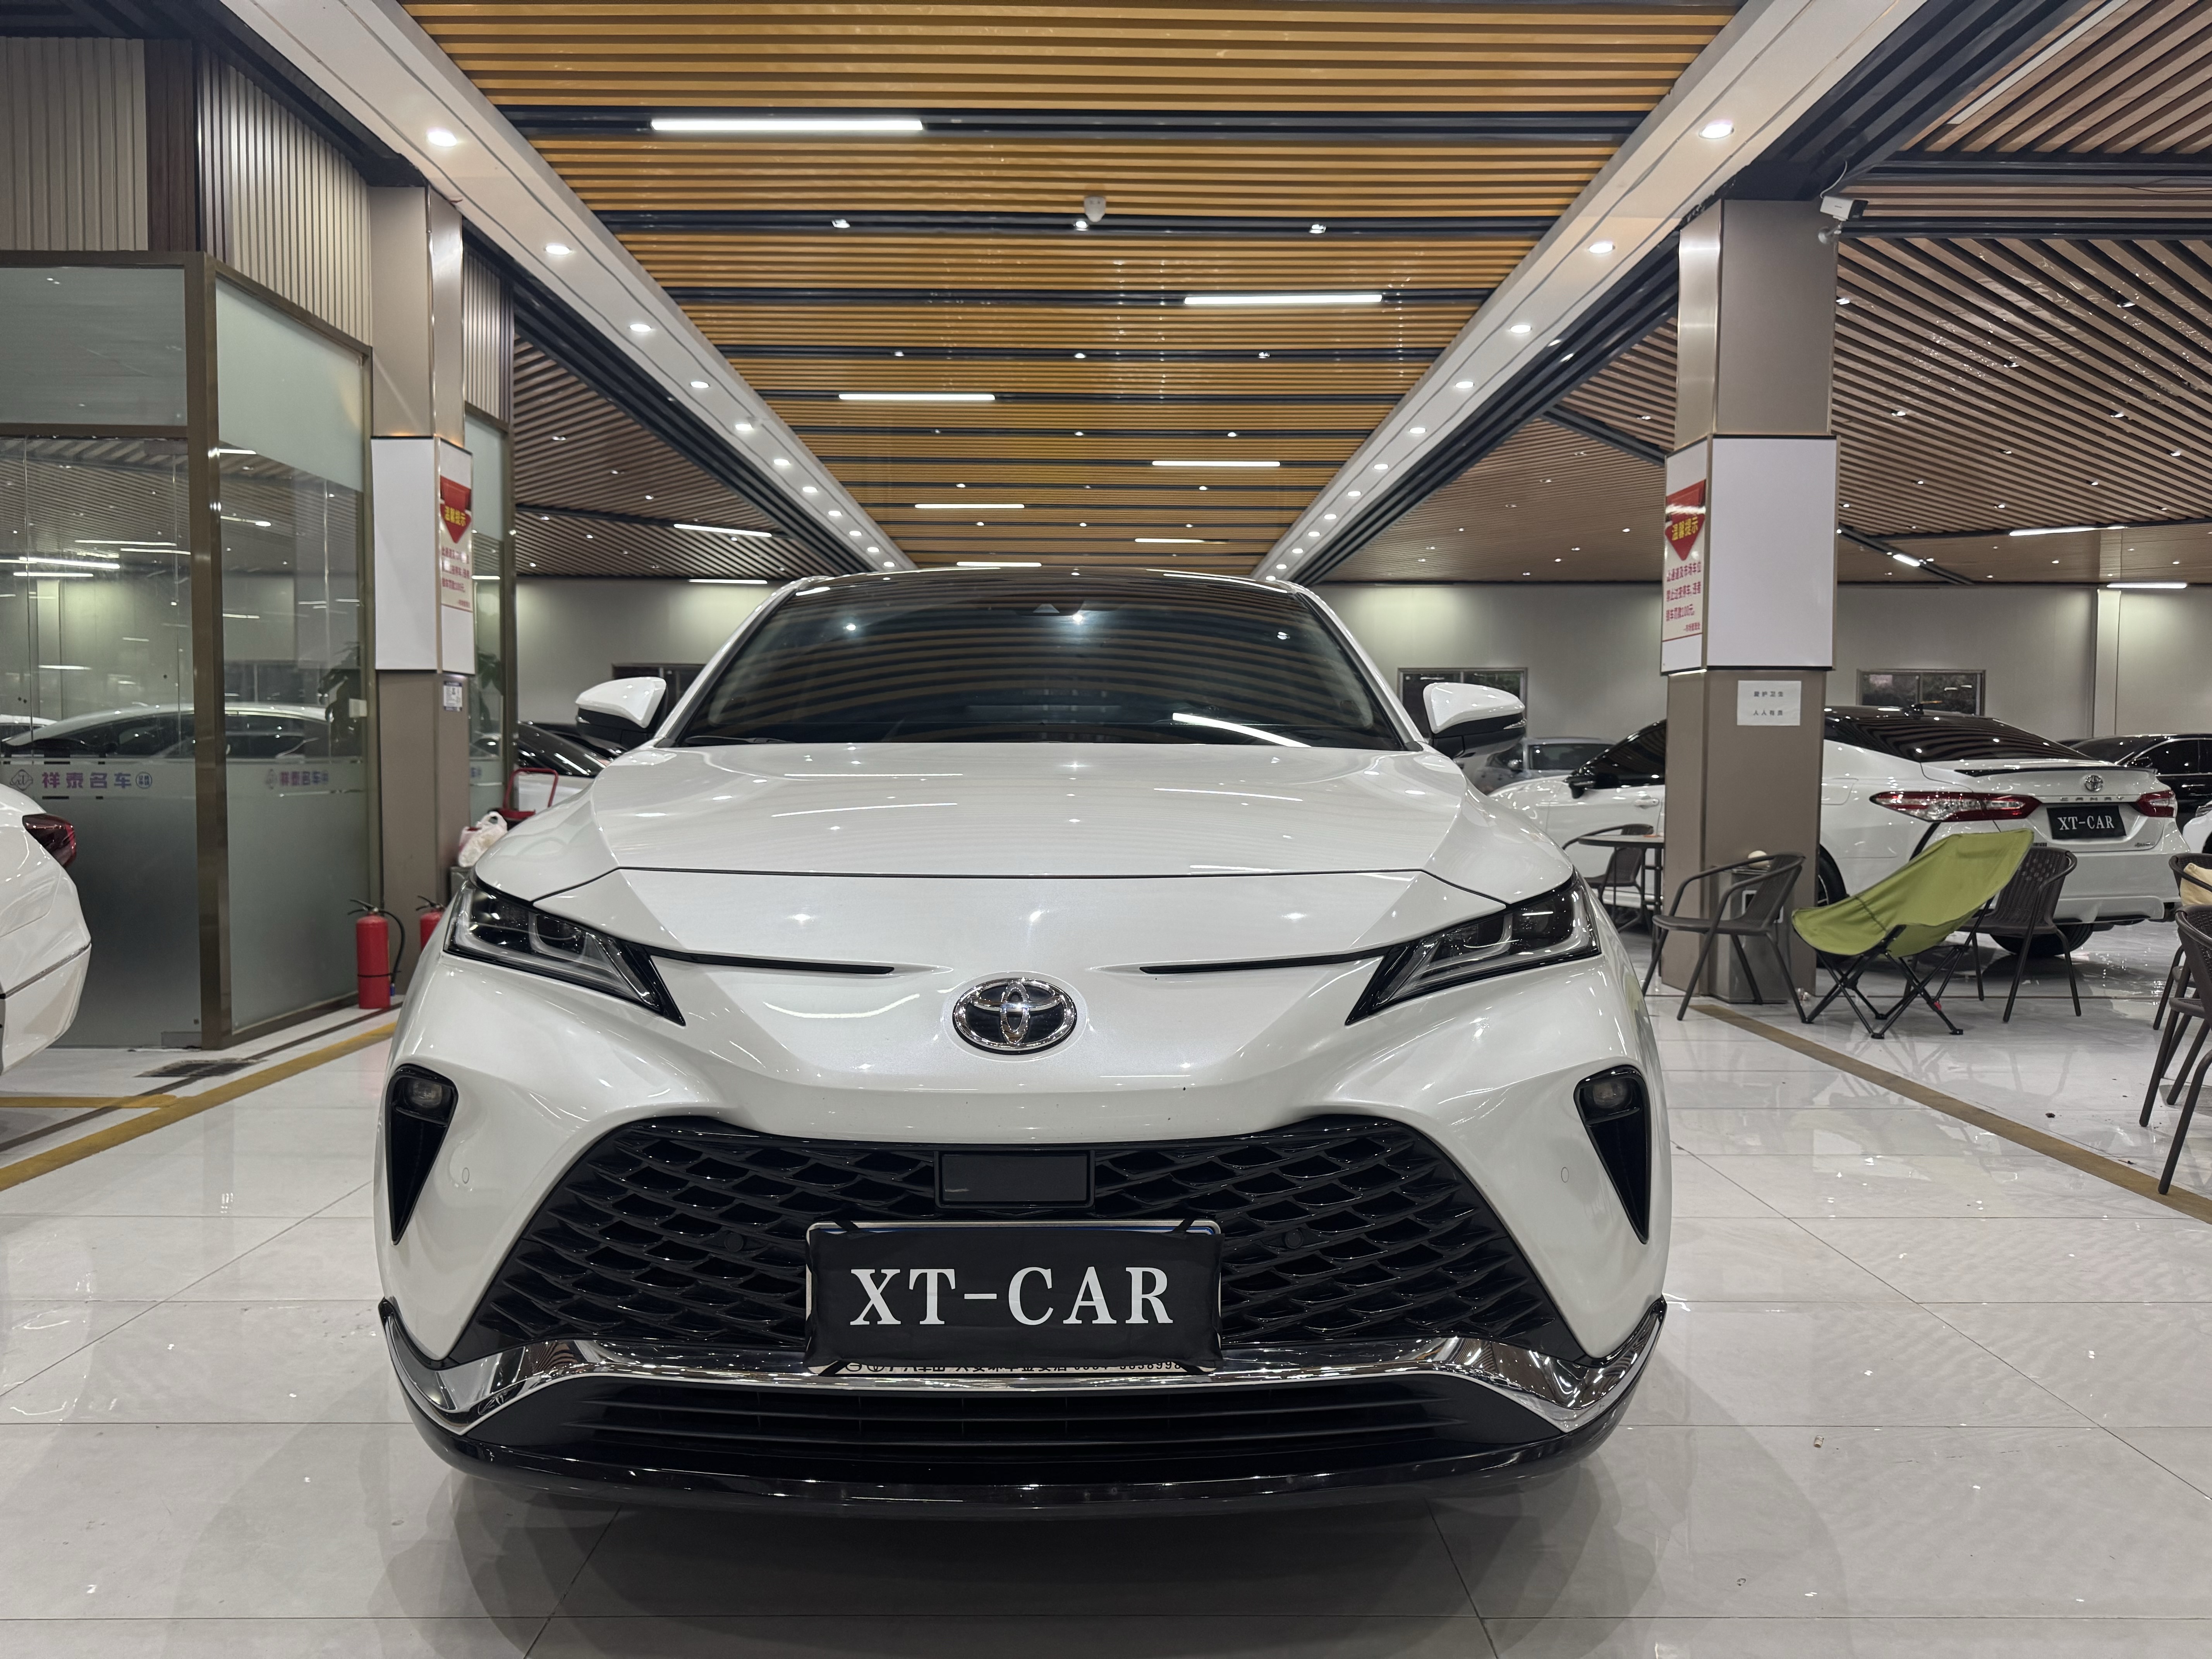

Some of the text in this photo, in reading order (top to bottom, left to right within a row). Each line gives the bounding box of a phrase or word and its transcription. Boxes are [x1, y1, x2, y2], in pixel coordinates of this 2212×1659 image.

[1672, 516, 1698, 541] 温馨提示
[42, 771, 131, 789] 祥泰名车
[2057, 815, 2114, 831] XT-CAR
[850, 1266, 1173, 1325] XT-CAR
